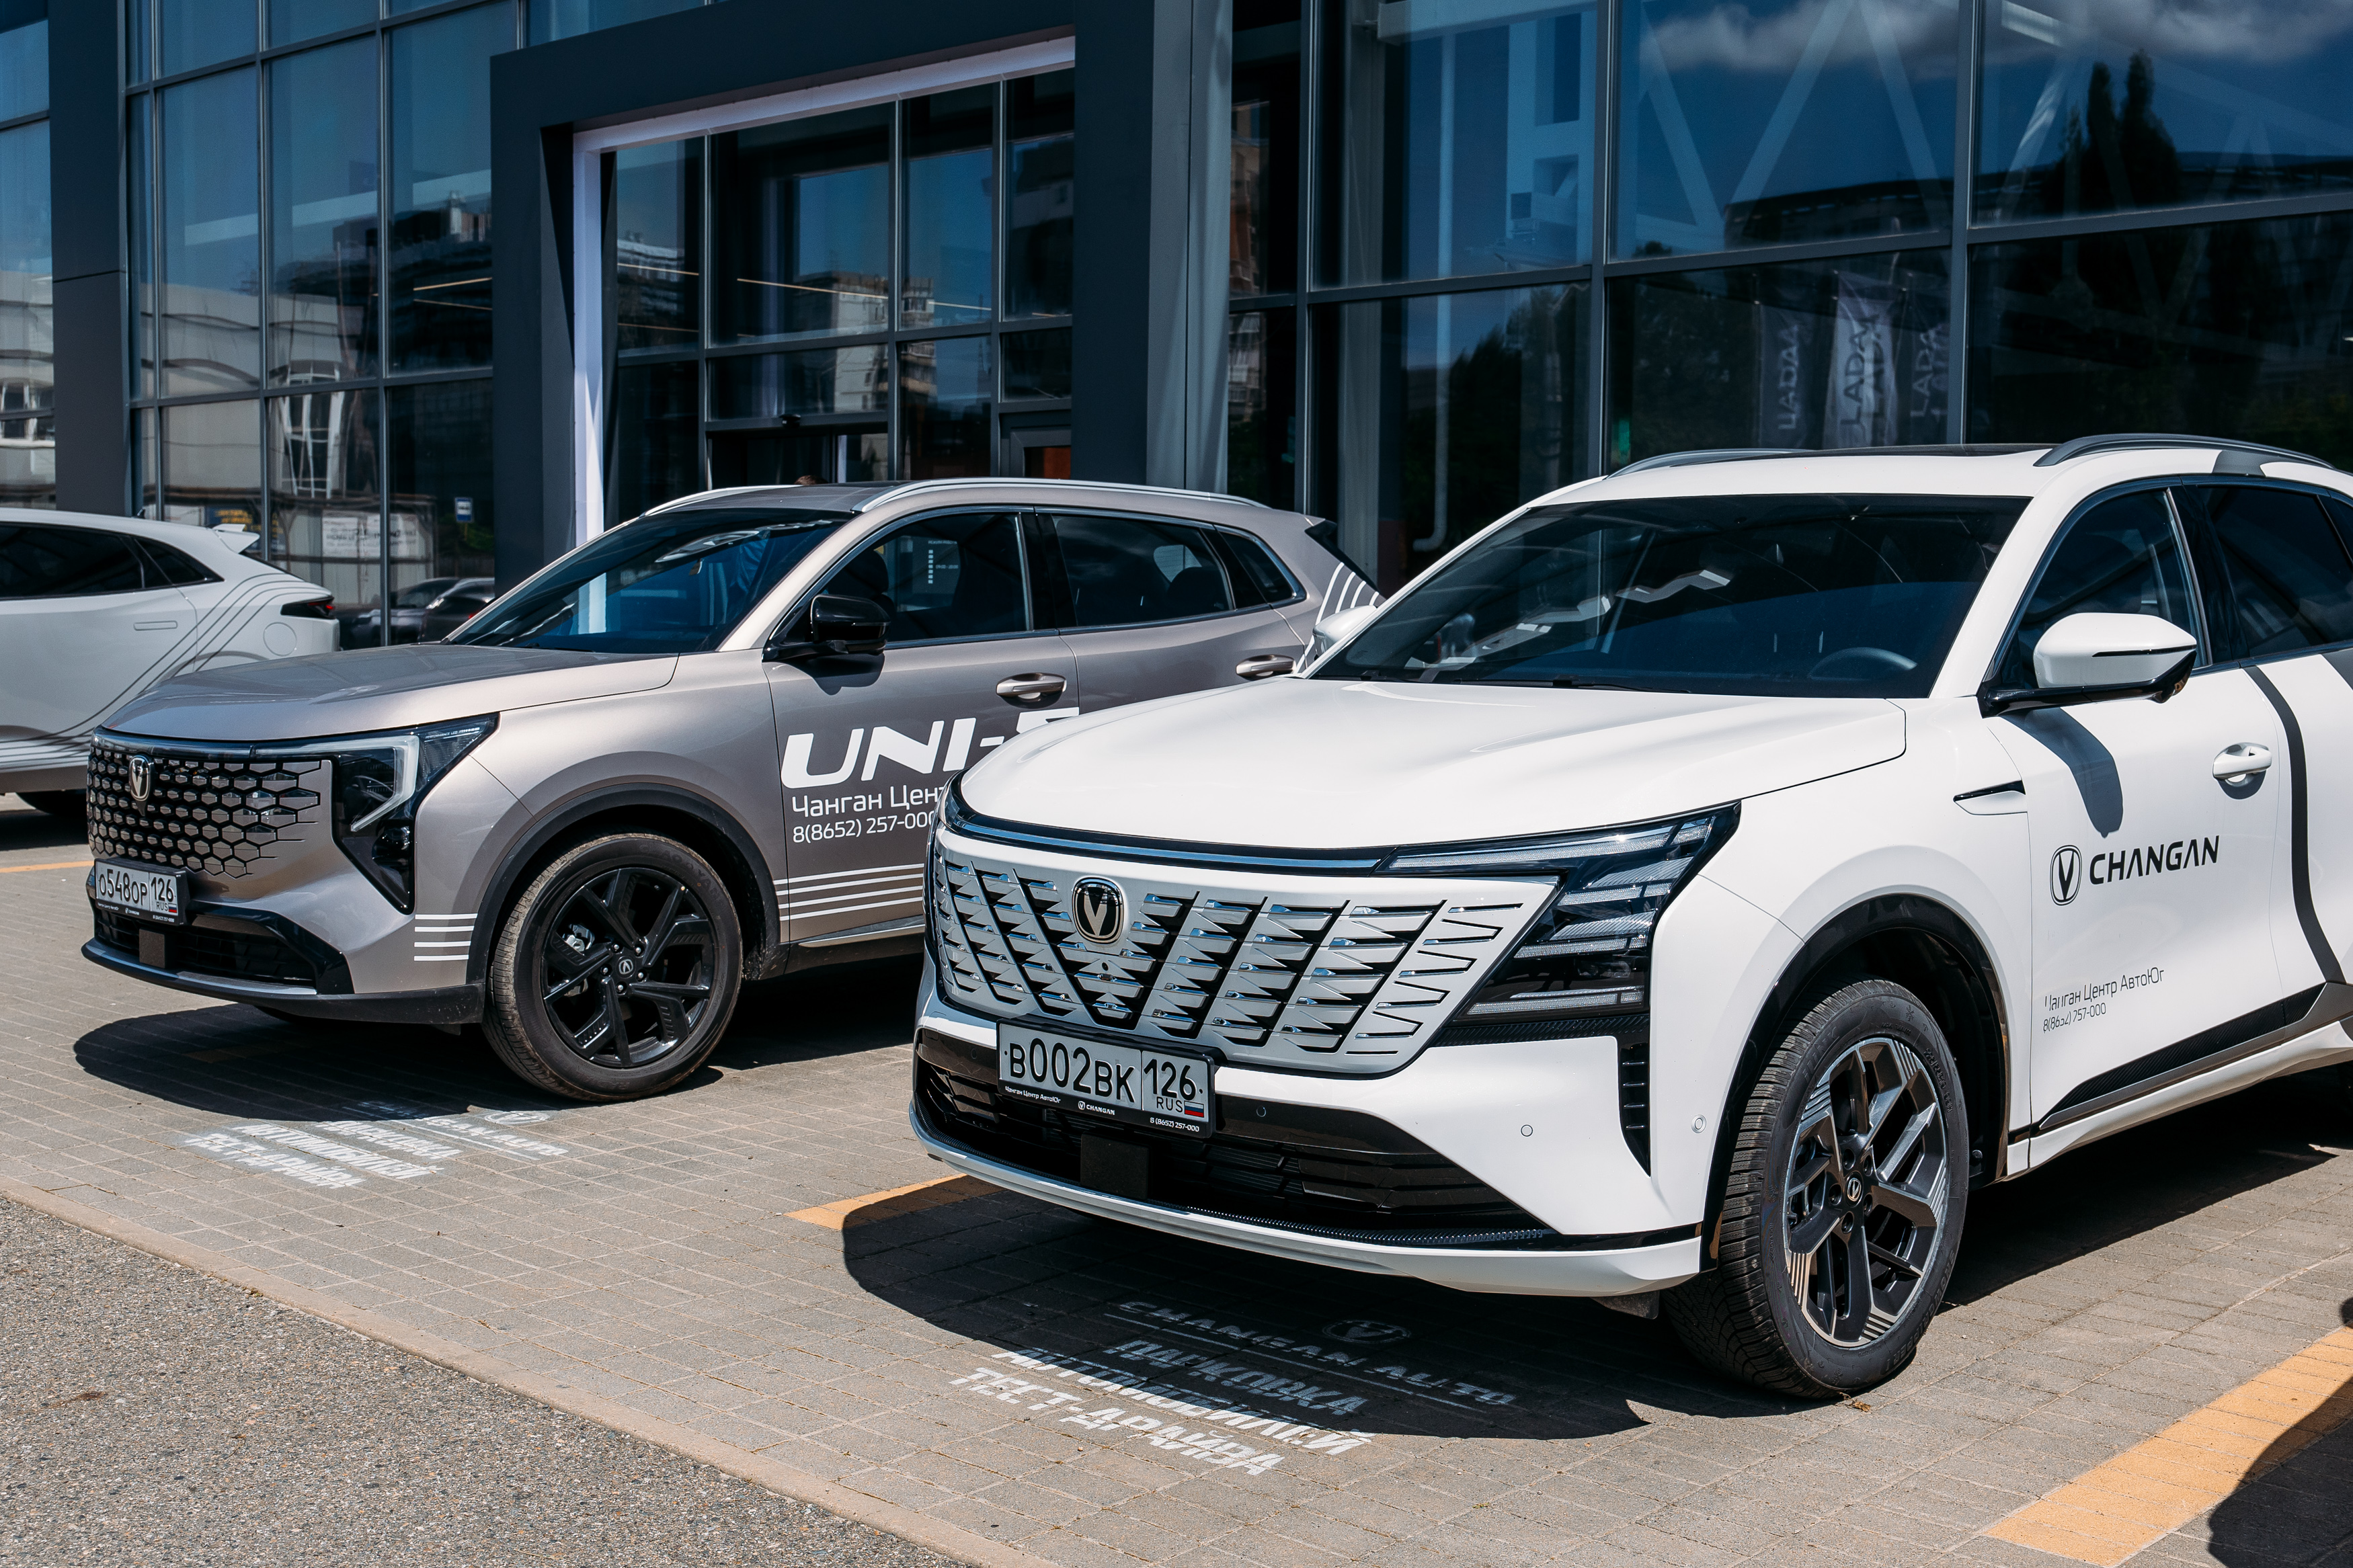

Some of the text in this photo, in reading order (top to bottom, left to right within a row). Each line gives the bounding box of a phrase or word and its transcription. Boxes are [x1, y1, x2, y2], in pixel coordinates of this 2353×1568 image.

[793, 793, 882, 818] Чанган
[793, 818, 862, 843] 8(8652)
[2089, 835, 2220, 885] CHANGAN
[151, 876, 174, 903] 126
[156, 901, 168, 911] RUS
[2083, 980, 2117, 1003] Центр
[2120, 966, 2165, 992] АвтоЮг
[1144, 1058, 1197, 1101] 126
[1005, 1085, 1062, 1104] Чанган Центр АвтоЮг
[1156, 1096, 1183, 1113] RUS
[1086, 1104, 1115, 1116] CHANGAN
[1155, 1118, 1175, 1128] (8652)
[1175, 1121, 1200, 1132] 257-000
